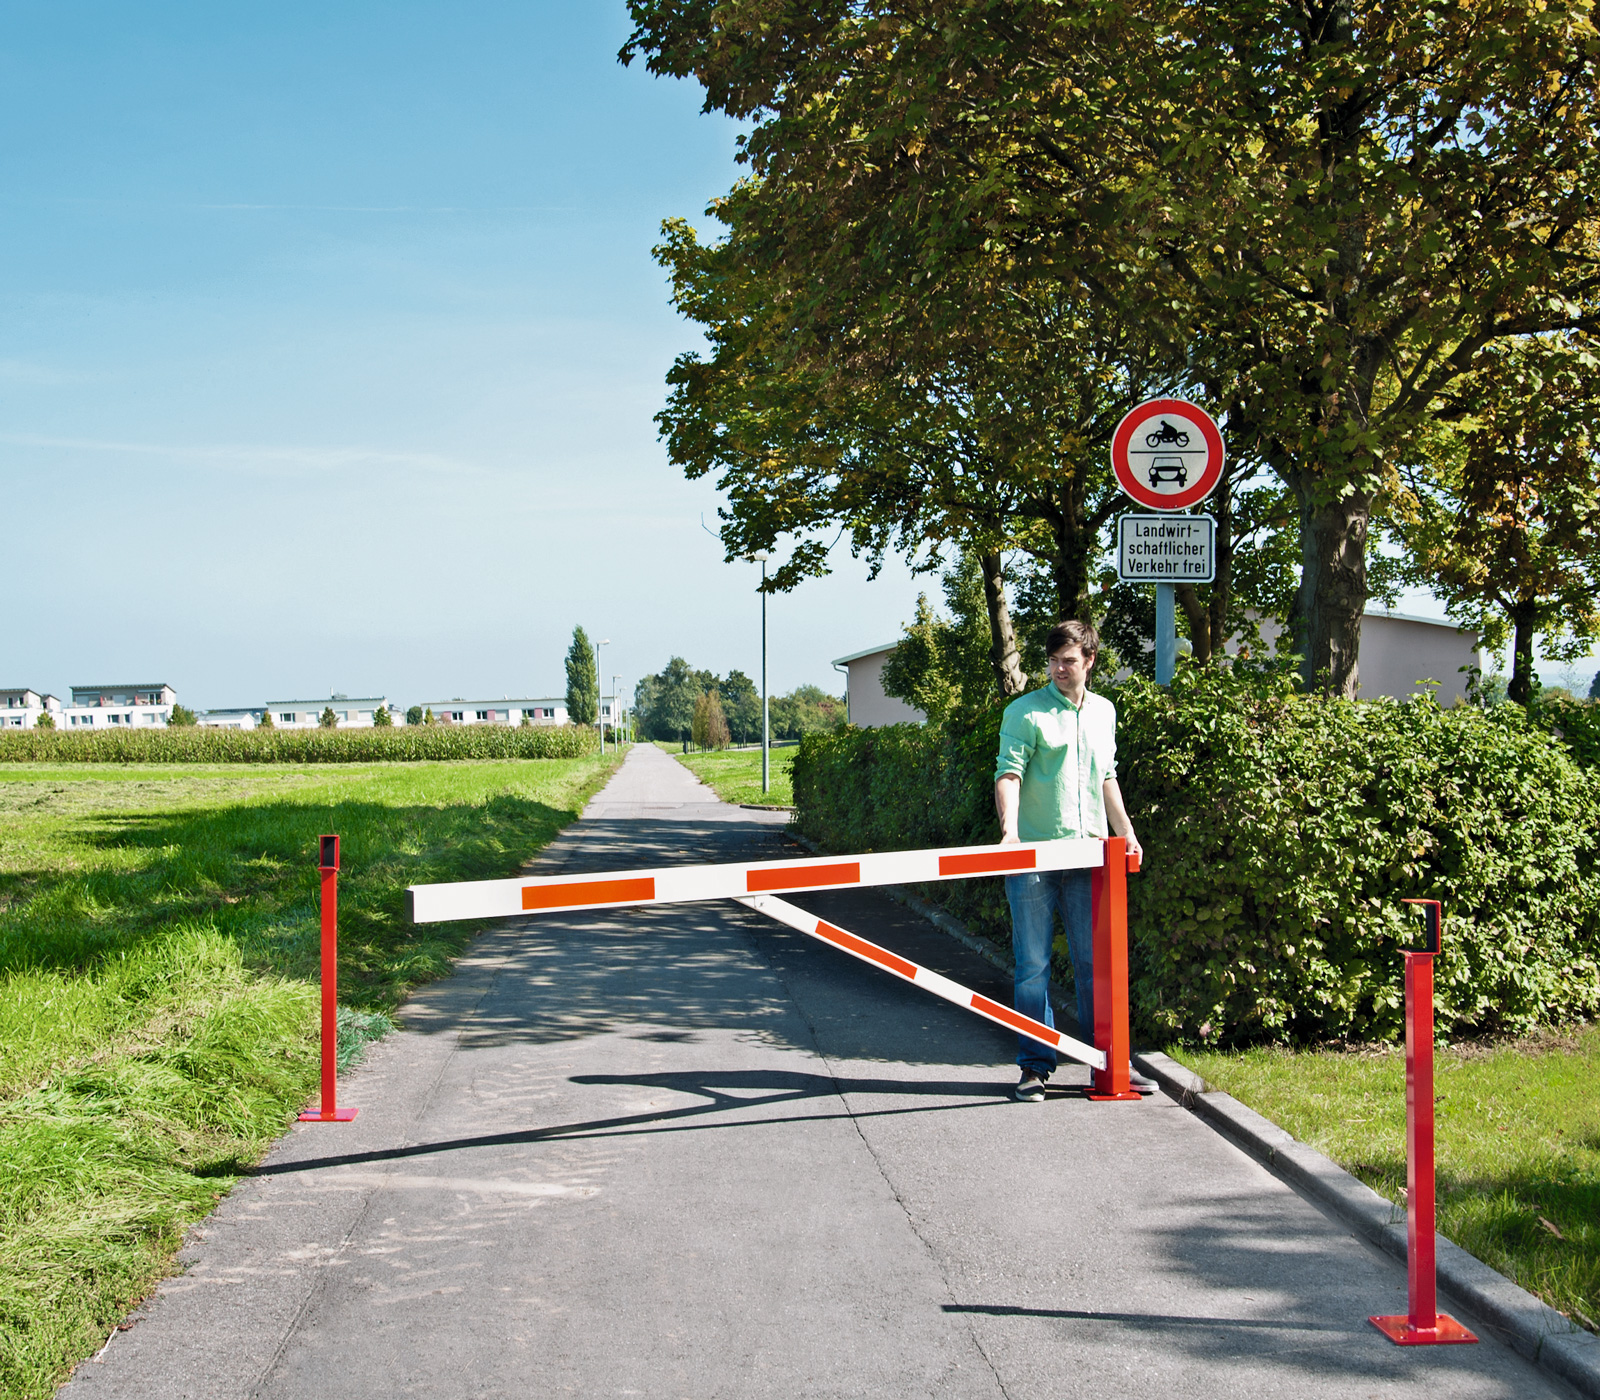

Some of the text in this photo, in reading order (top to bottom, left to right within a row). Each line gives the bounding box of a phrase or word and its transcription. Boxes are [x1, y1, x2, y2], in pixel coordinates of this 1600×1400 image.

[1135, 522, 1200, 538] Landwirt-
[1128, 540, 1205, 556] schaftlicher
[1128, 558, 1206, 574] Verkehr frei
